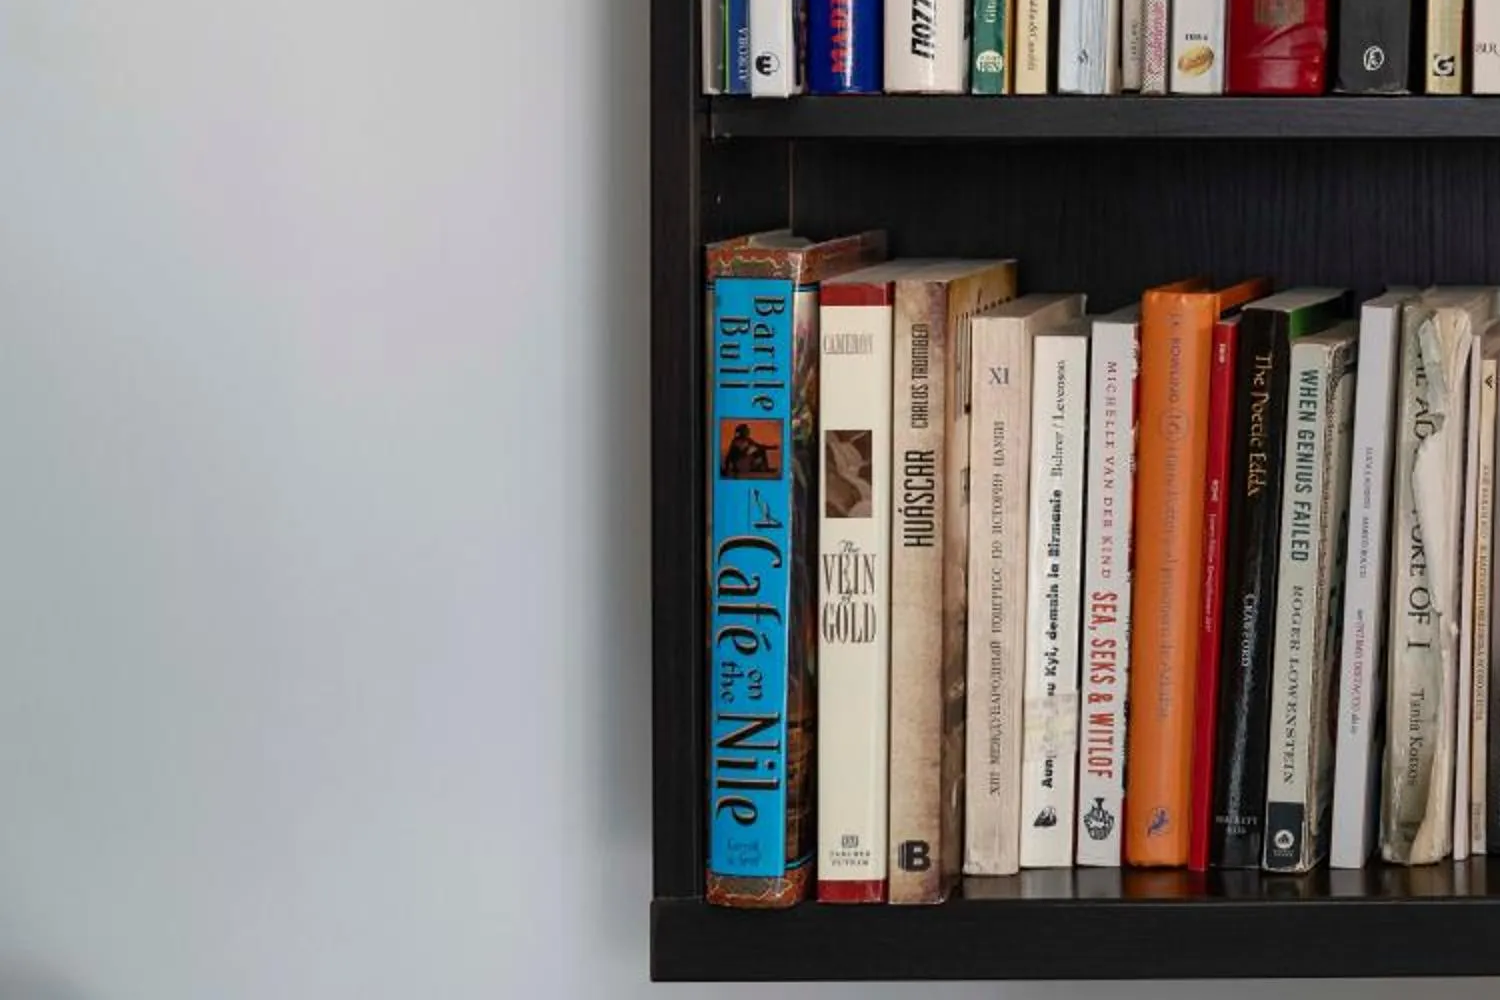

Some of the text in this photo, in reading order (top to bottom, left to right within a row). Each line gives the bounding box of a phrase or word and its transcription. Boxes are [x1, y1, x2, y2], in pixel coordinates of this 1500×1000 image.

[718, 314, 751, 390] Bull
[751, 294, 785, 412] Bartle
[910, 385, 929, 429] CARLOS
[1246, 351, 1273, 497] The Poetic Edda
[897, 449, 936, 548] HUÁSCAR
[1046, 489, 1063, 558] Birmanie
[716, 487, 784, 657] A Café
[822, 553, 877, 596] VEIN
[1046, 563, 1061, 579] la
[1087, 361, 1118, 780] MICHELLE VAN DER KIND SEA, SEKS & WITLOF
[1281, 368, 1320, 786] WHEN GENIUS FAILED ROGER LOWENSTEIN
[1407, 586, 1431, 626] OF
[822, 602, 877, 645] GOLD
[719, 660, 744, 705] the
[747, 669, 765, 702] on
[715, 711, 782, 826] Nile
